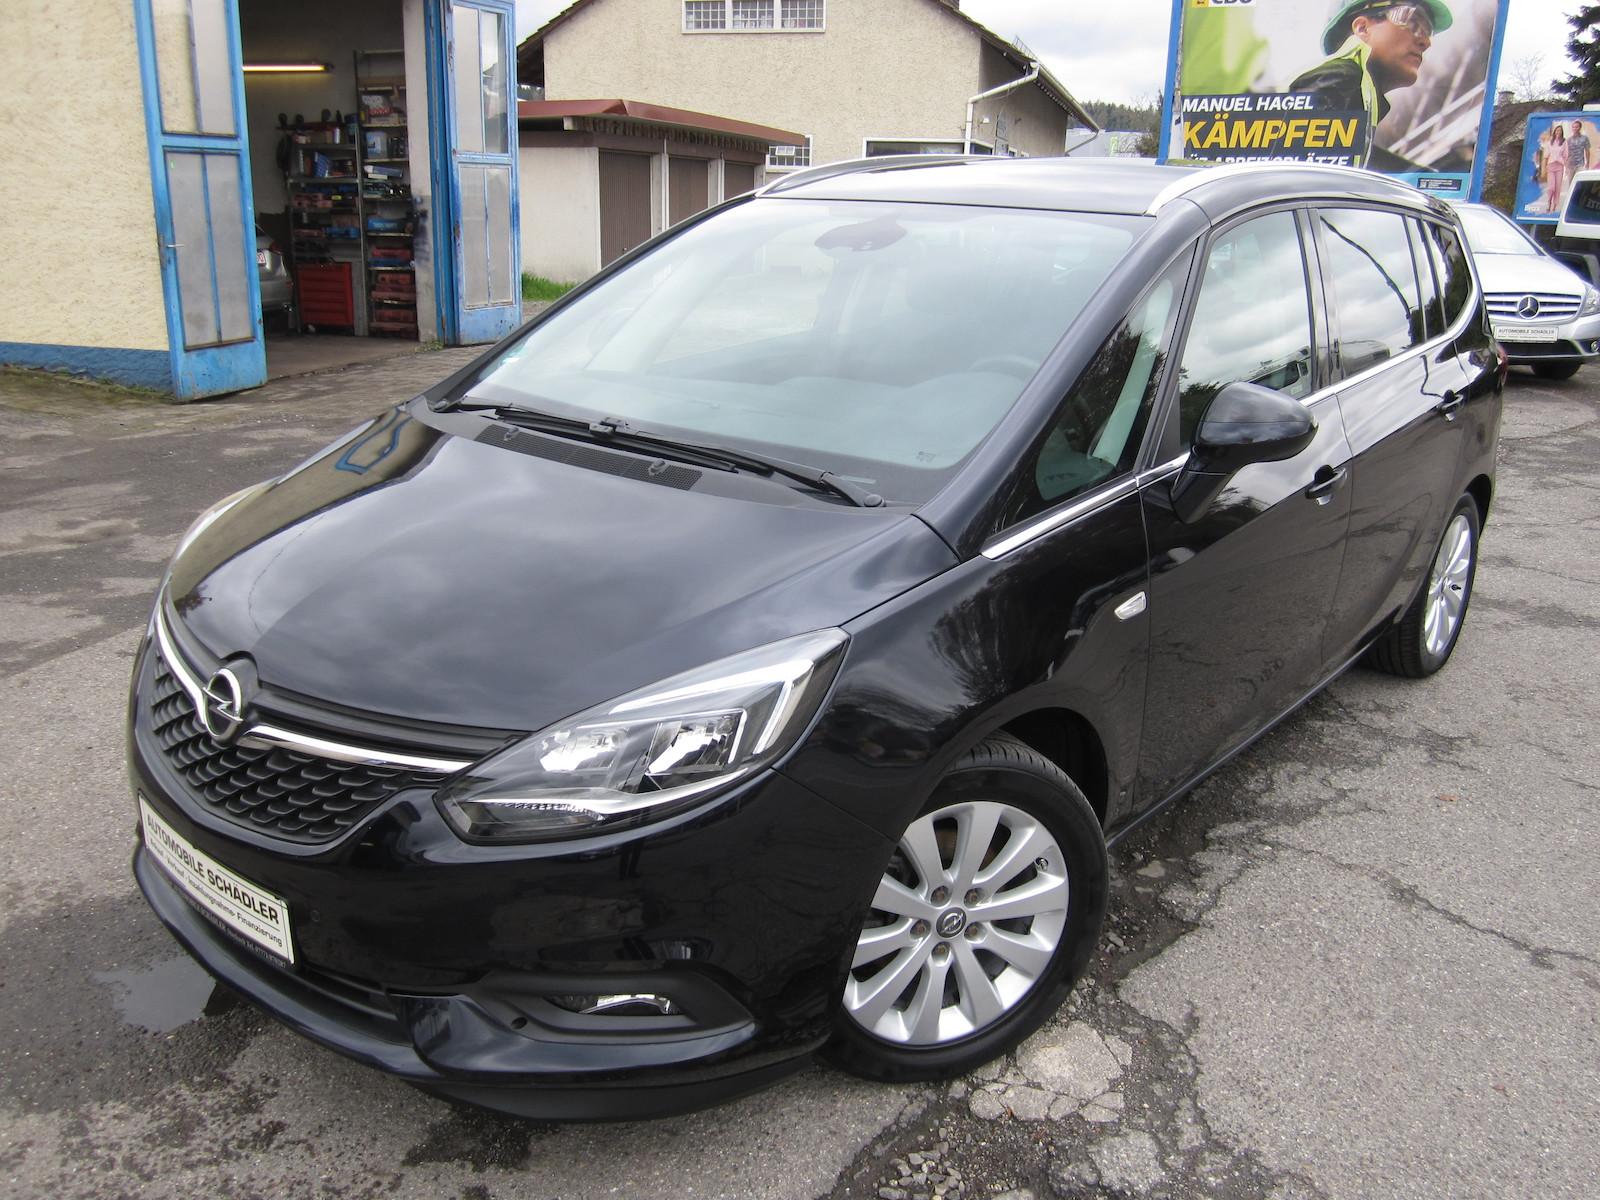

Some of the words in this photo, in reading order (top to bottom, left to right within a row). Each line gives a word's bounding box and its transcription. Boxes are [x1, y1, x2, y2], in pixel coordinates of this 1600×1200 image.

[1183, 97, 1253, 112] MANUEL
[1256, 96, 1314, 111] HAGEL
[1184, 113, 1358, 149] KÄMPFEN
[147, 814, 205, 878] AUTOMOBILE
[207, 869, 279, 924] SCHÄDLER
[237, 912, 283, 947] Finanzierung
